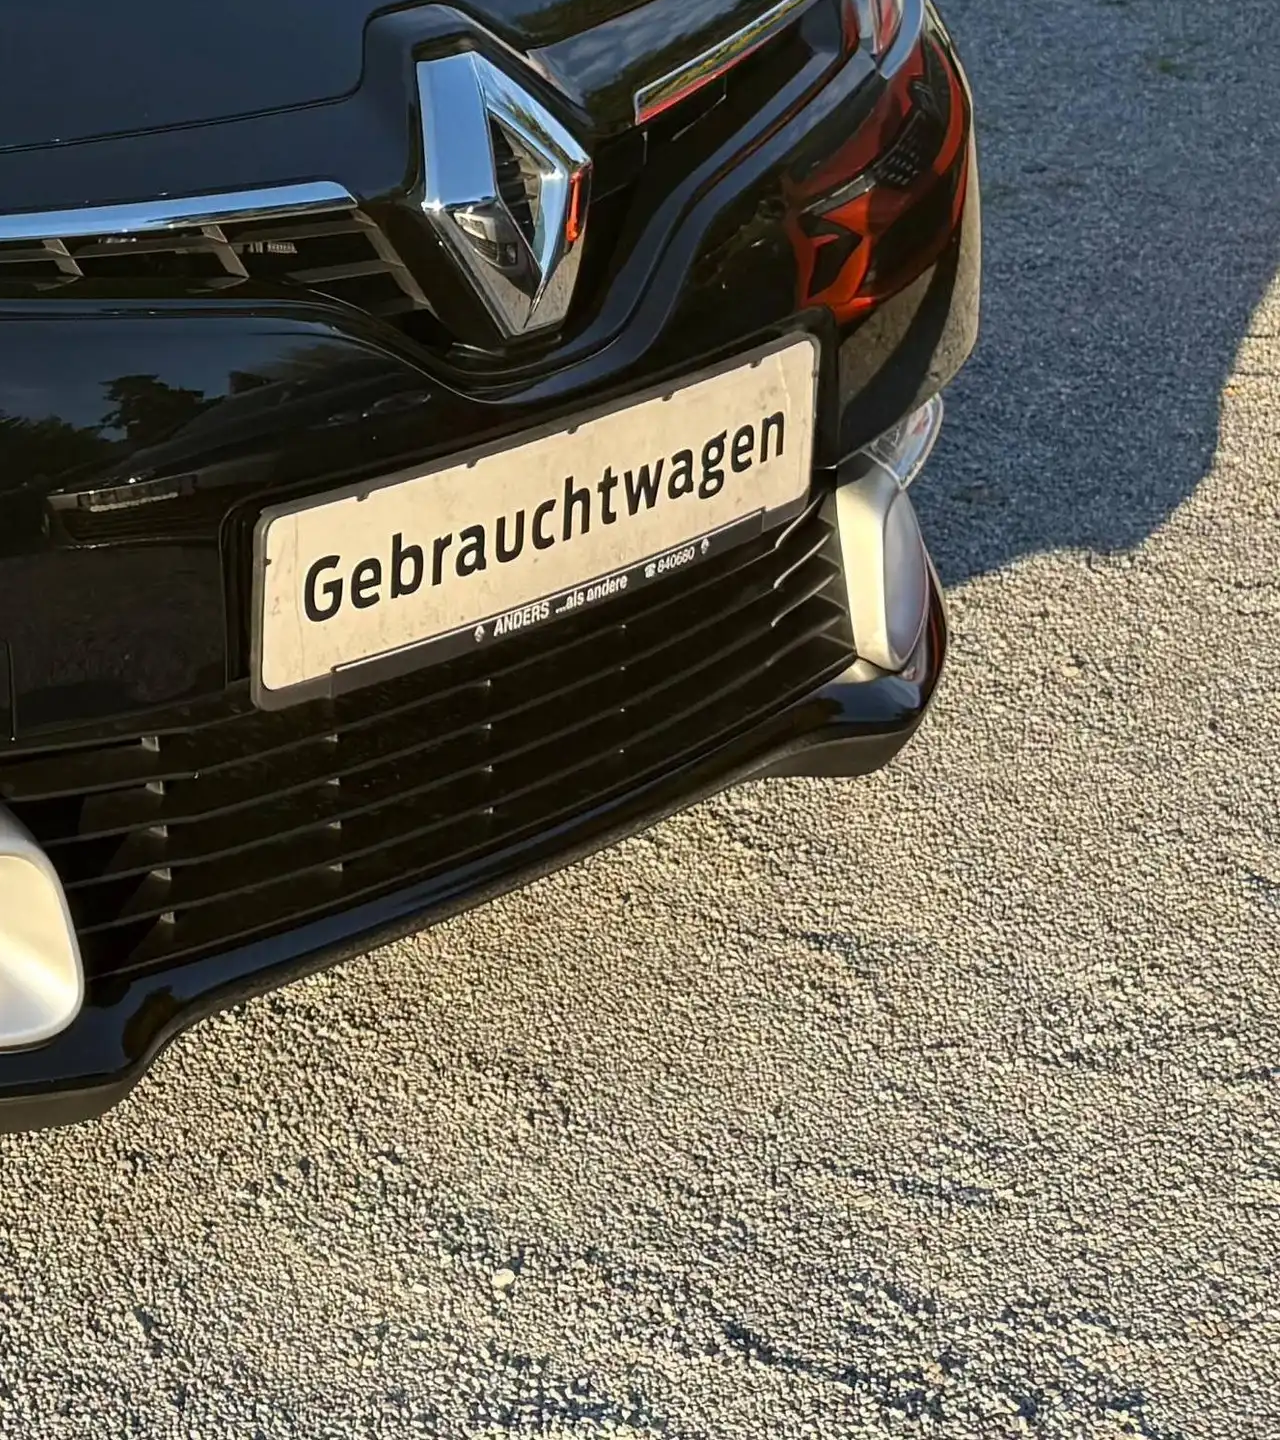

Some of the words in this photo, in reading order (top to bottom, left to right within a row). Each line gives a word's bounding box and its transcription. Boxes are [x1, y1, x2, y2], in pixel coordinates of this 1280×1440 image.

[303, 410, 785, 622] Gebrauchtwagen
[493, 602, 550, 637] ANDERS
[586, 575, 628, 603] andere
